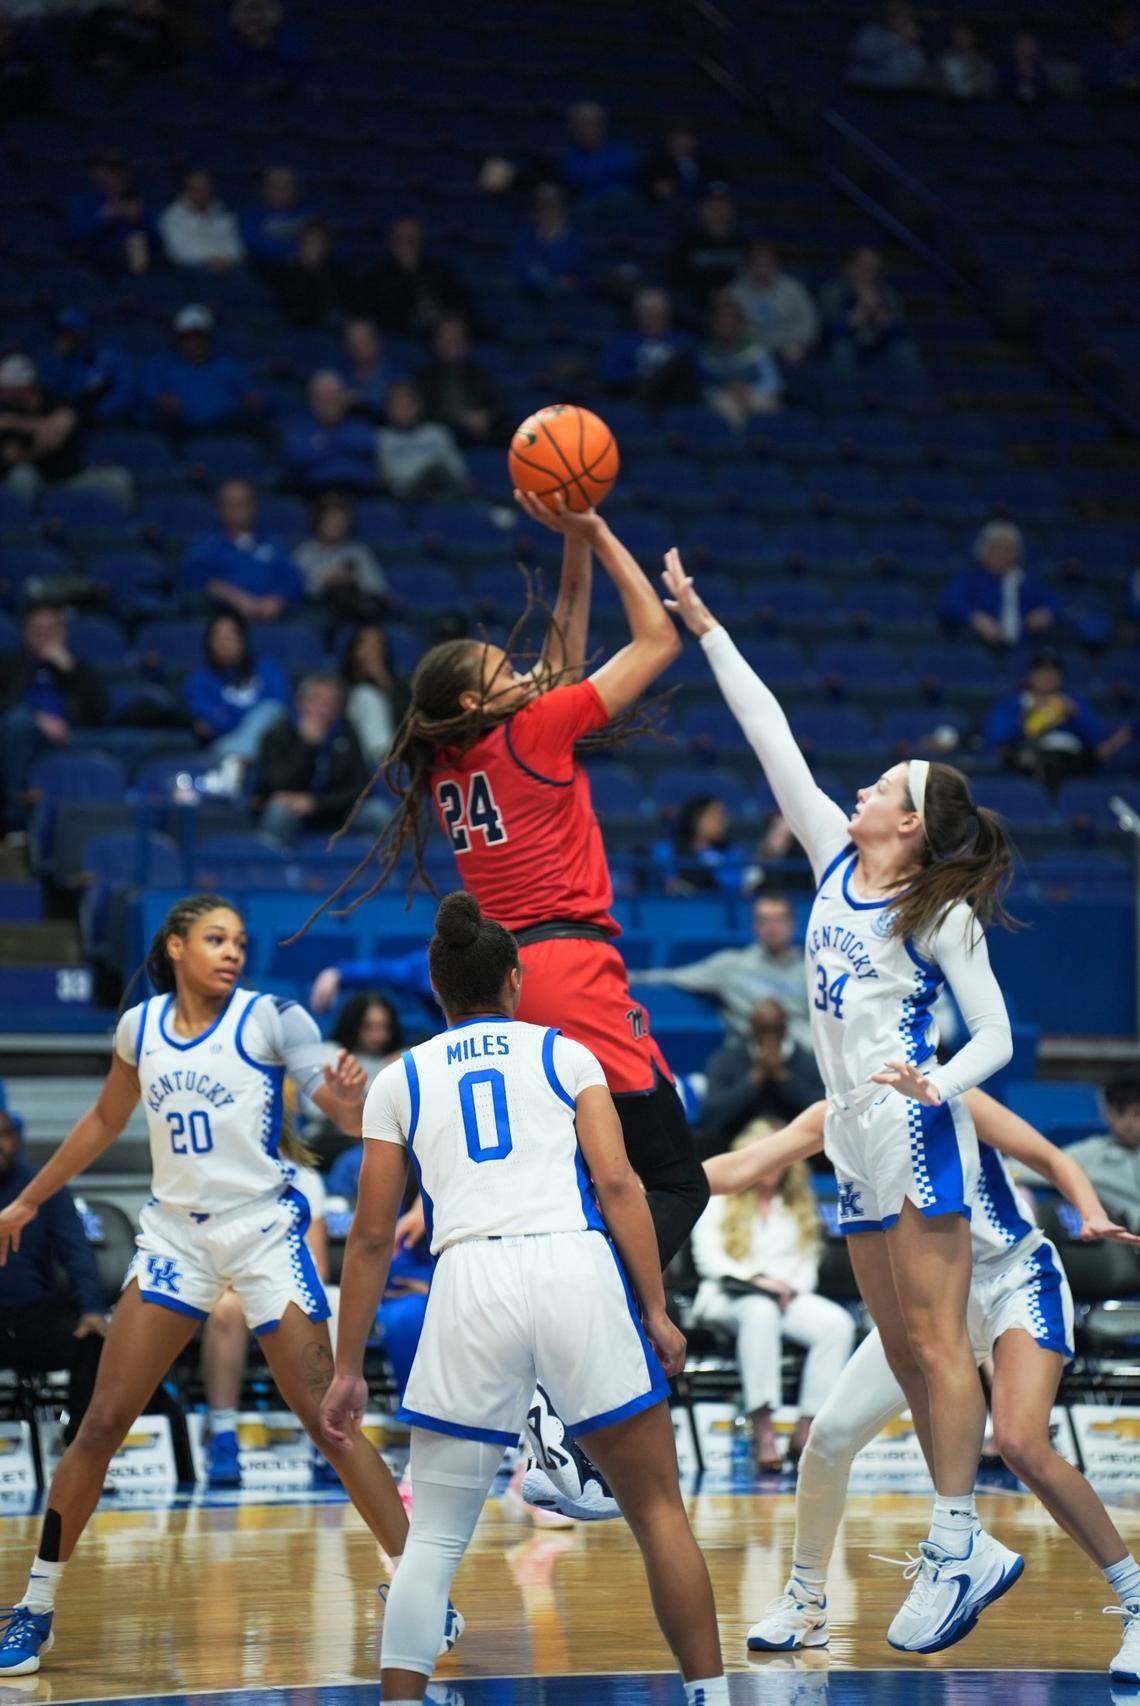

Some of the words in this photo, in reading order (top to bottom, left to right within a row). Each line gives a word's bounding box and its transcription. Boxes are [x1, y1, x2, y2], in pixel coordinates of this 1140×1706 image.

[435, 770, 509, 855] 24
[809, 925, 879, 979] KENTUCKY
[814, 964, 851, 1020] 34
[447, 1034, 510, 1065] MILES
[146, 1070, 235, 1113] KENTUCKY
[458, 1067, 513, 1164] 0
[165, 1109, 214, 1155] 20
[146, 1255, 184, 1295] UK
